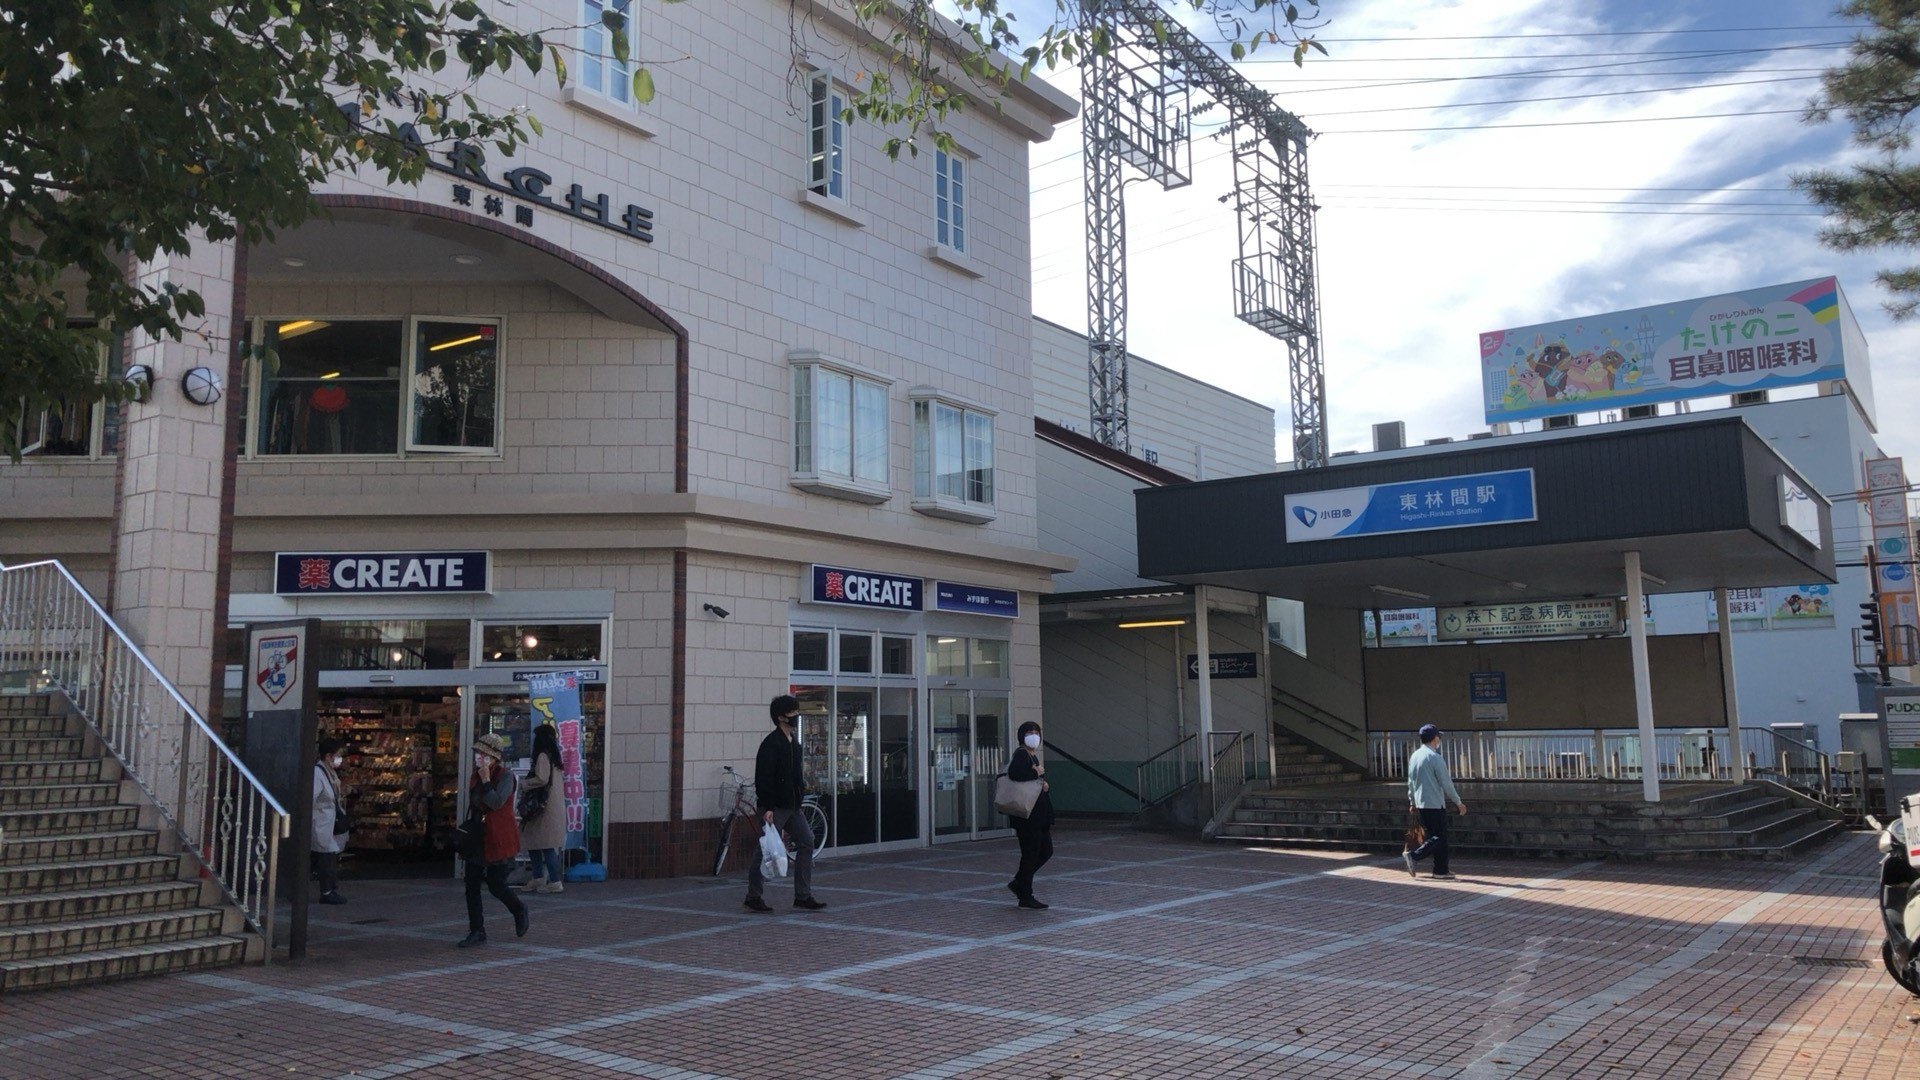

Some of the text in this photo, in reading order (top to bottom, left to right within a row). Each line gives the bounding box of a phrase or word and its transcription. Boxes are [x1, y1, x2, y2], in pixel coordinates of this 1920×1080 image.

[452, 184, 534, 228] 東林間
[1483, 336, 1500, 350] 2F
[1680, 313, 1799, 352] たけのこ
[1668, 337, 1818, 382] 耳鼻咽喉科
[1399, 484, 1496, 511] 東林間駅
[1320, 508, 1352, 519] 小田急
[1400, 507, 1483, 521] Higashi-Rinkan Station
[298, 558, 464, 589] 薬 CREATE
[825, 571, 912, 607] 薬 CREATE
[1465, 604, 1573, 624] 森下記念病院
